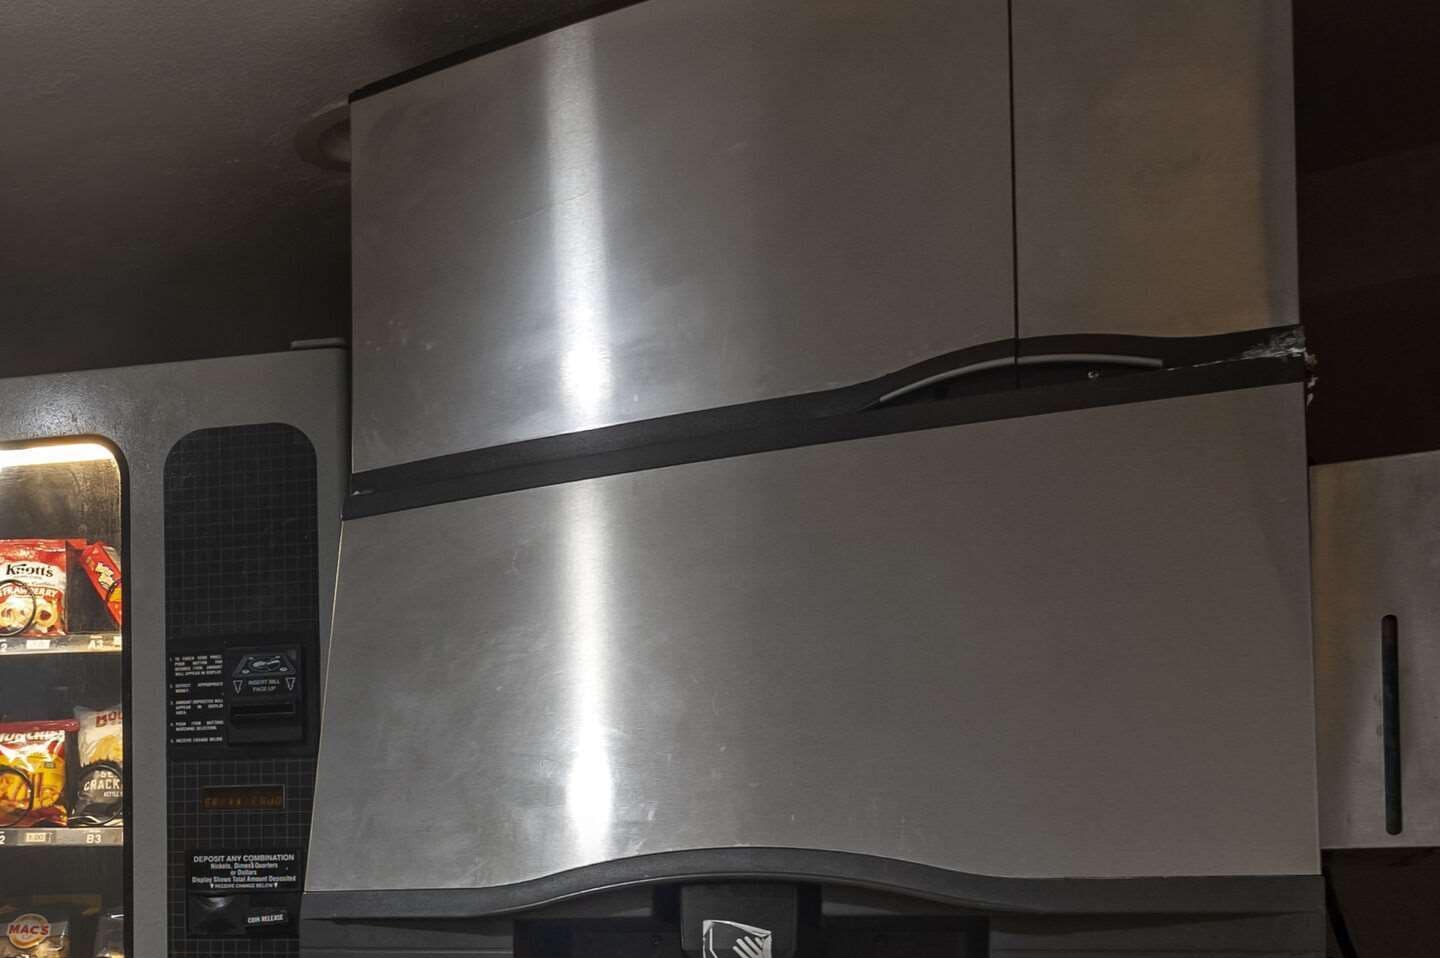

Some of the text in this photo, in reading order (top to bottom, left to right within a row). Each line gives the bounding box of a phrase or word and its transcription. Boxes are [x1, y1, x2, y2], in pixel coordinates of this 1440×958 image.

[88, 640, 104, 649] A3
[86, 834, 101, 843] B3
[193, 855, 225, 863] DEPOSIT
[243, 854, 295, 862] COMBINATION
